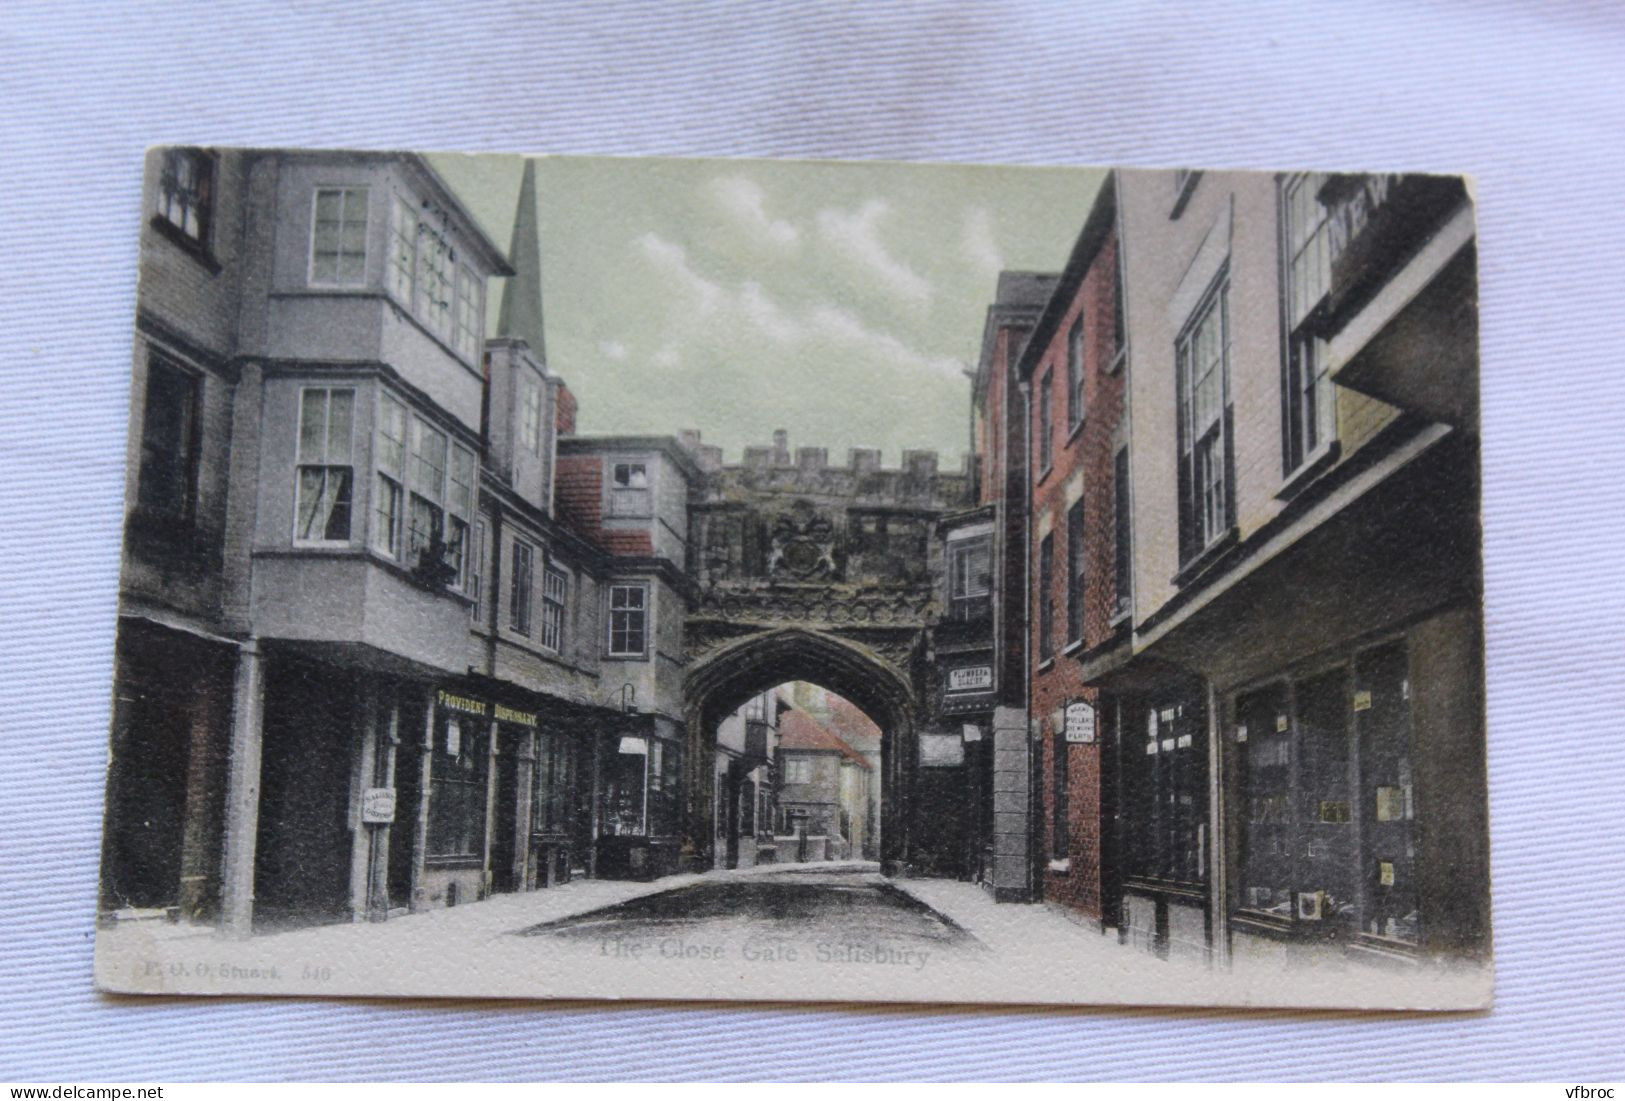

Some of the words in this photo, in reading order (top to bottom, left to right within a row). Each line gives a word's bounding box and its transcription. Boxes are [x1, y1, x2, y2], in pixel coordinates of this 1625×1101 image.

[438, 689, 486, 715] PROVIDENT
[599, 940, 643, 958] The
[659, 938, 725, 960] Close
[741, 943, 798, 962] Gate
[815, 941, 931, 971] Salisbury
